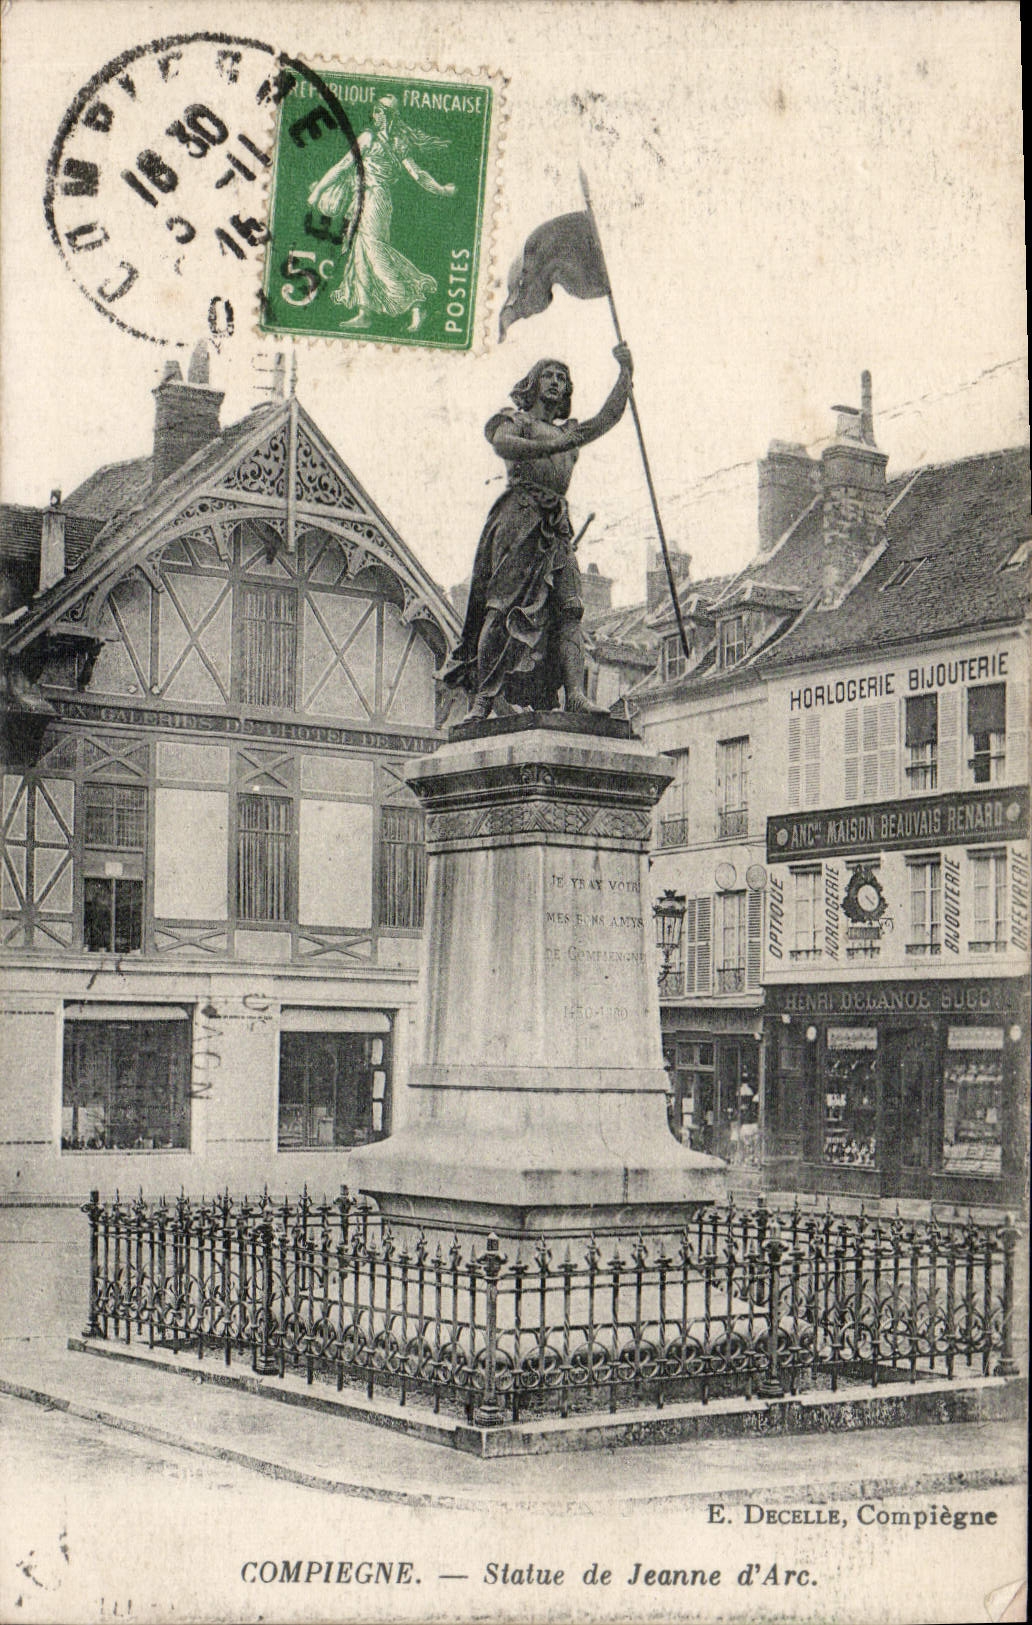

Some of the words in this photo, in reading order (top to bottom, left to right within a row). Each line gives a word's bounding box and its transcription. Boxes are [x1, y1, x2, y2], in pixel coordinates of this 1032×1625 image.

[402, 89, 482, 115] FRANÇAISE
[445, 248, 470, 333] POSTES
[789, 673, 896, 712] HORLOGERIE
[908, 652, 1010, 691] BIJOUTERIE
[826, 816, 875, 845] MAISON
[880, 808, 943, 840] BEAUVAIS
[948, 801, 1004, 833] RENARD
[768, 873, 785, 960] OPTIQUE
[823, 863, 841, 962] HORLOGERIE
[943, 856, 962, 955] BIJOUTERIE
